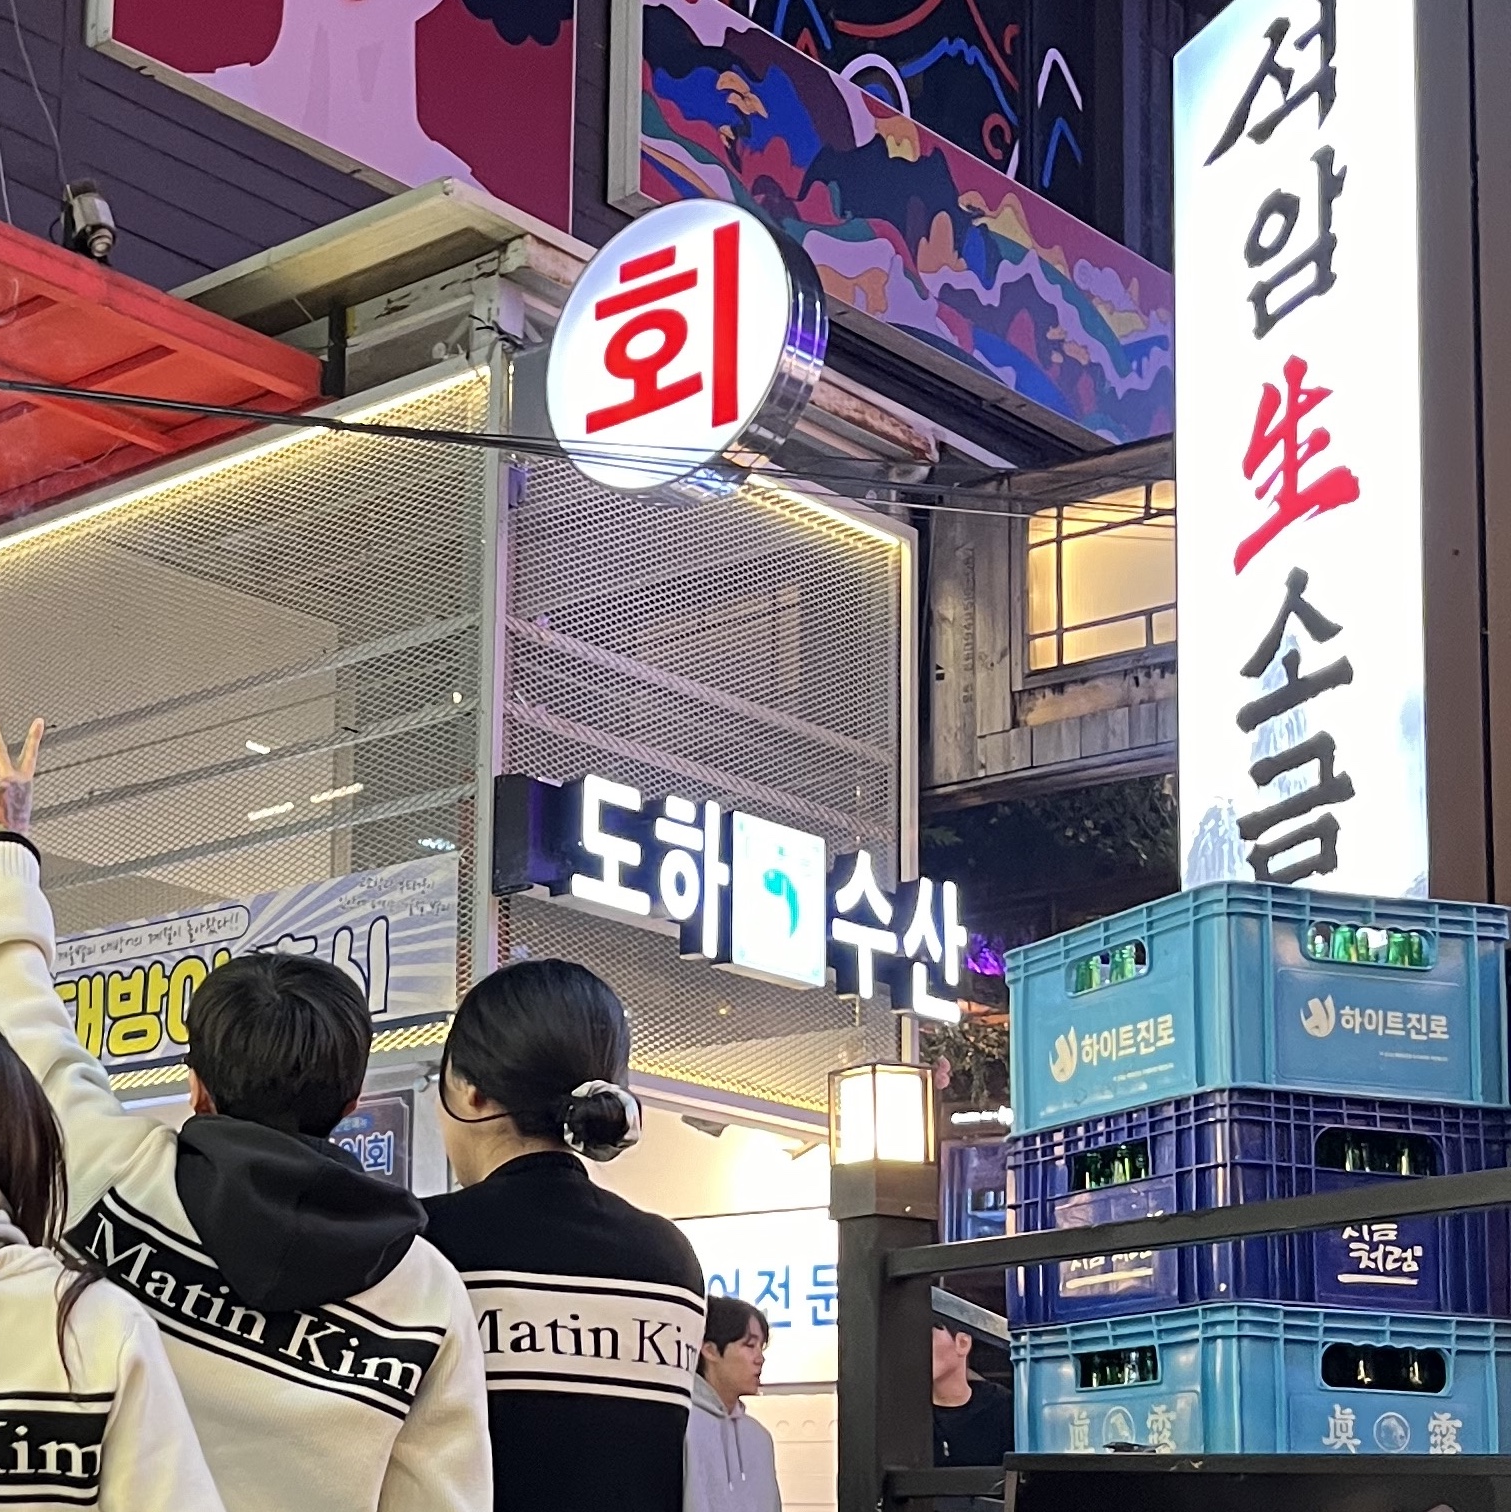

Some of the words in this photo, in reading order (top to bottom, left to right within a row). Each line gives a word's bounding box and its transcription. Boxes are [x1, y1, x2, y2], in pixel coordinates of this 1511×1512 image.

[584, 219, 743, 435] 회
[570, 772, 731, 962] 도하
[832, 848, 969, 1026] 수산
[1081, 1013, 1177, 1066] 하이트진로
[1340, 1005, 1450, 1041] 하이트진로
[85, 1212, 270, 1344] Matin
[279, 1310, 422, 1396] Kim
[1348, 1242, 1419, 1273] 처럼
